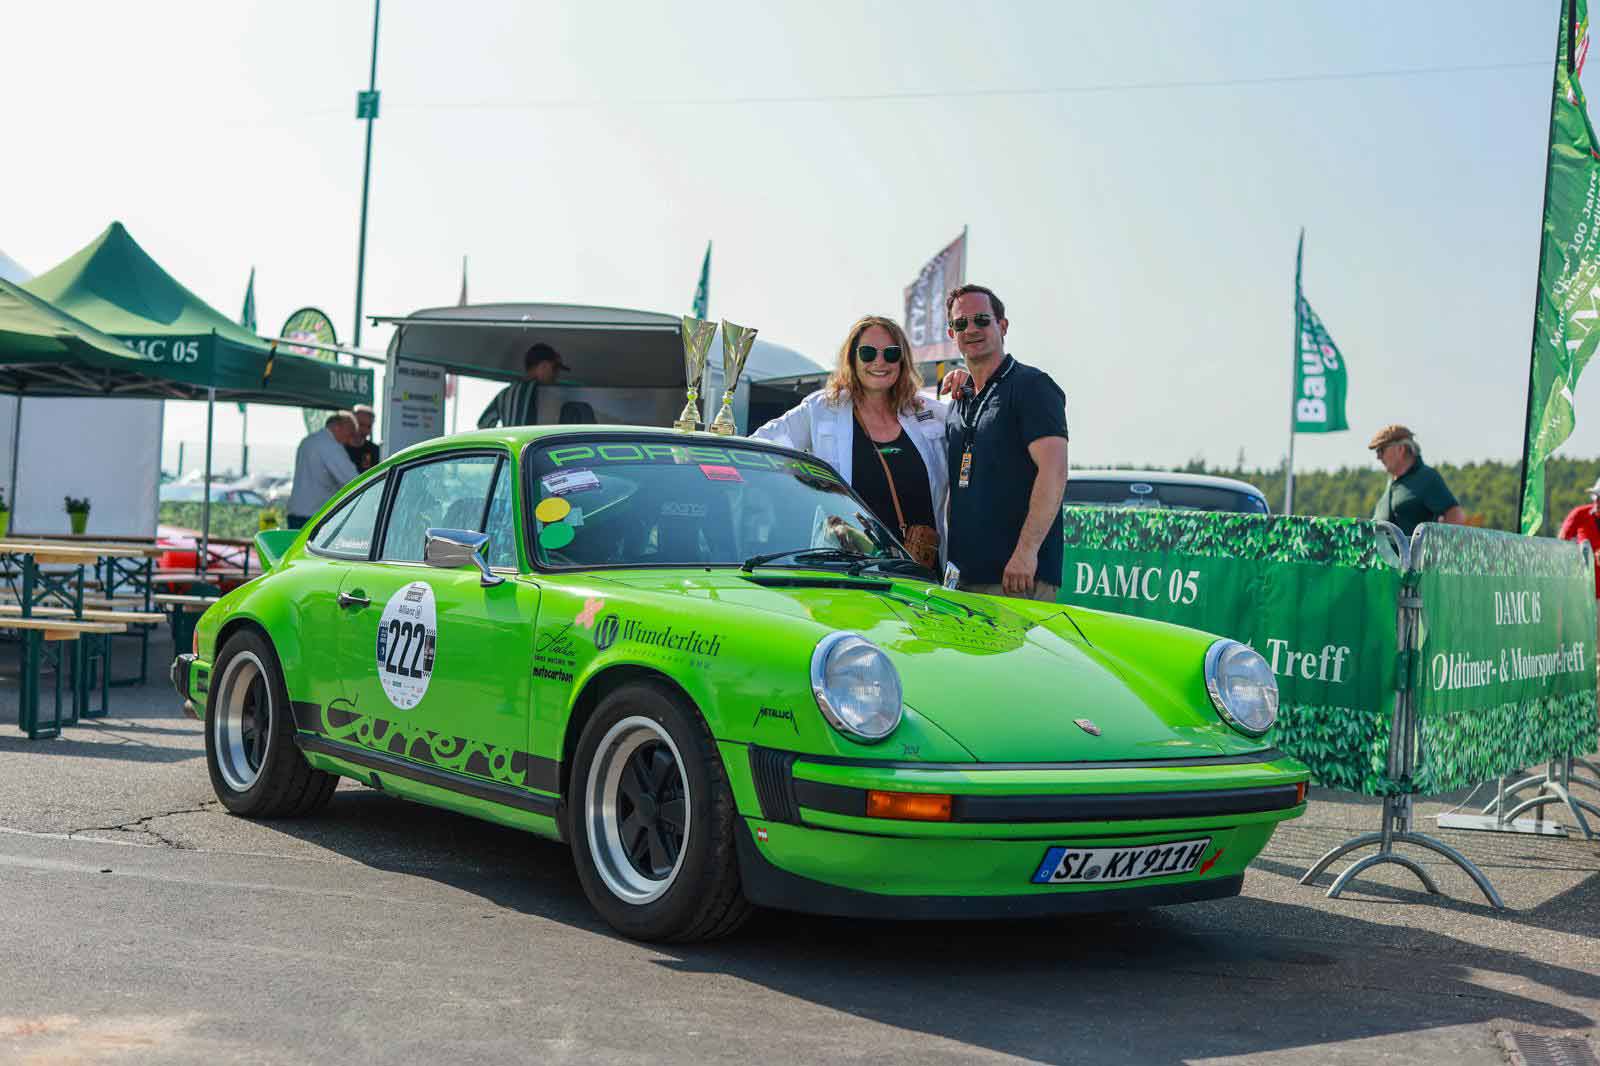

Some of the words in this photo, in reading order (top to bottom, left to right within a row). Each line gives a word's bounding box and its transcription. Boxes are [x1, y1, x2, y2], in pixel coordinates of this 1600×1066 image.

[1568, 221, 1588, 254] 100
[1582, 170, 1597, 220] Jahre
[126, 339, 167, 362] MC
[172, 341, 199, 363] 05
[549, 445, 840, 483] PORSCHE
[1074, 561, 1162, 601] DAMC
[1168, 568, 1201, 604] 05
[1494, 591, 1530, 625] DAMC
[1532, 591, 1541, 624] 05
[385, 618, 427, 679] 222
[622, 618, 721, 657] Wunderlich
[1266, 638, 1351, 683] Treff
[1431, 652, 1497, 691] Oldtimer-
[1499, 648, 1509, 683] &
[320, 693, 527, 785] Carrera
[1055, 853, 1093, 880] SI
